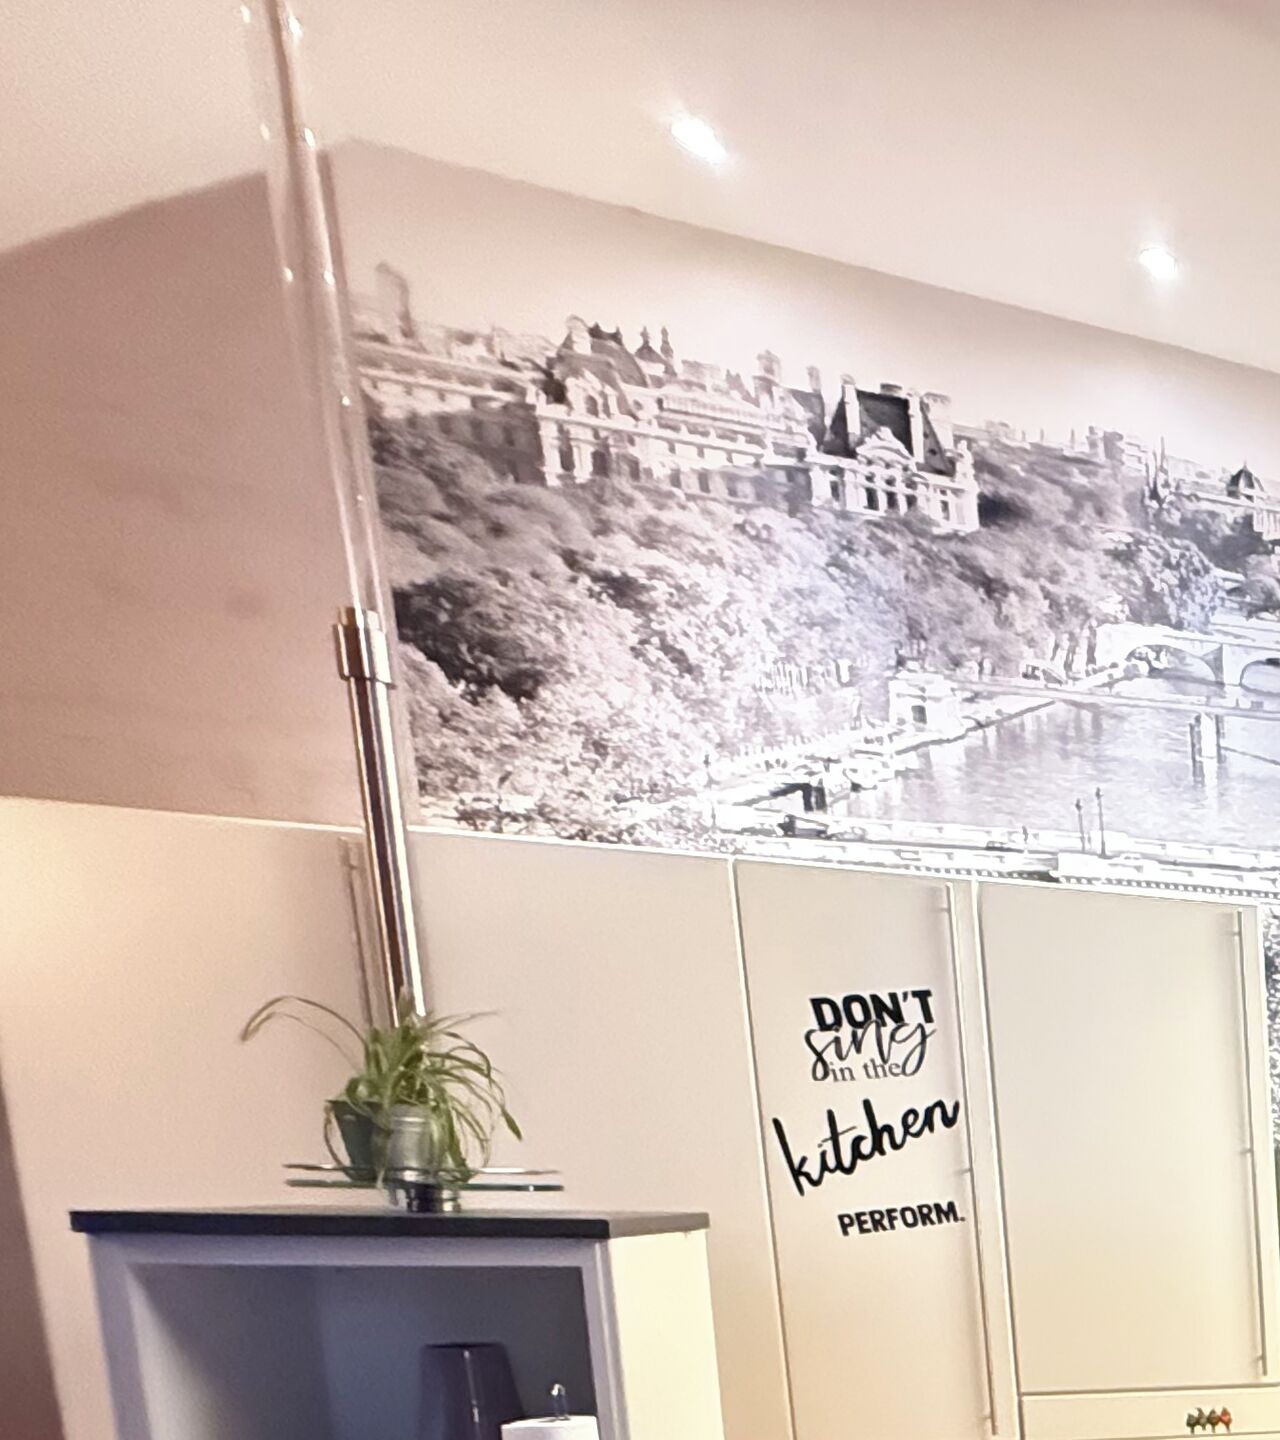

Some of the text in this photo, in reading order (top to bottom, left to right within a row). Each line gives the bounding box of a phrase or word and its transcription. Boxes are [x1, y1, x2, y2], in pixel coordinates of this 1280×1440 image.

[809, 989, 934, 1032] DON'T
[829, 1059, 902, 1082] in the
[772, 1098, 960, 1197] kitchen
[837, 1201, 966, 1237] PERFORM.
